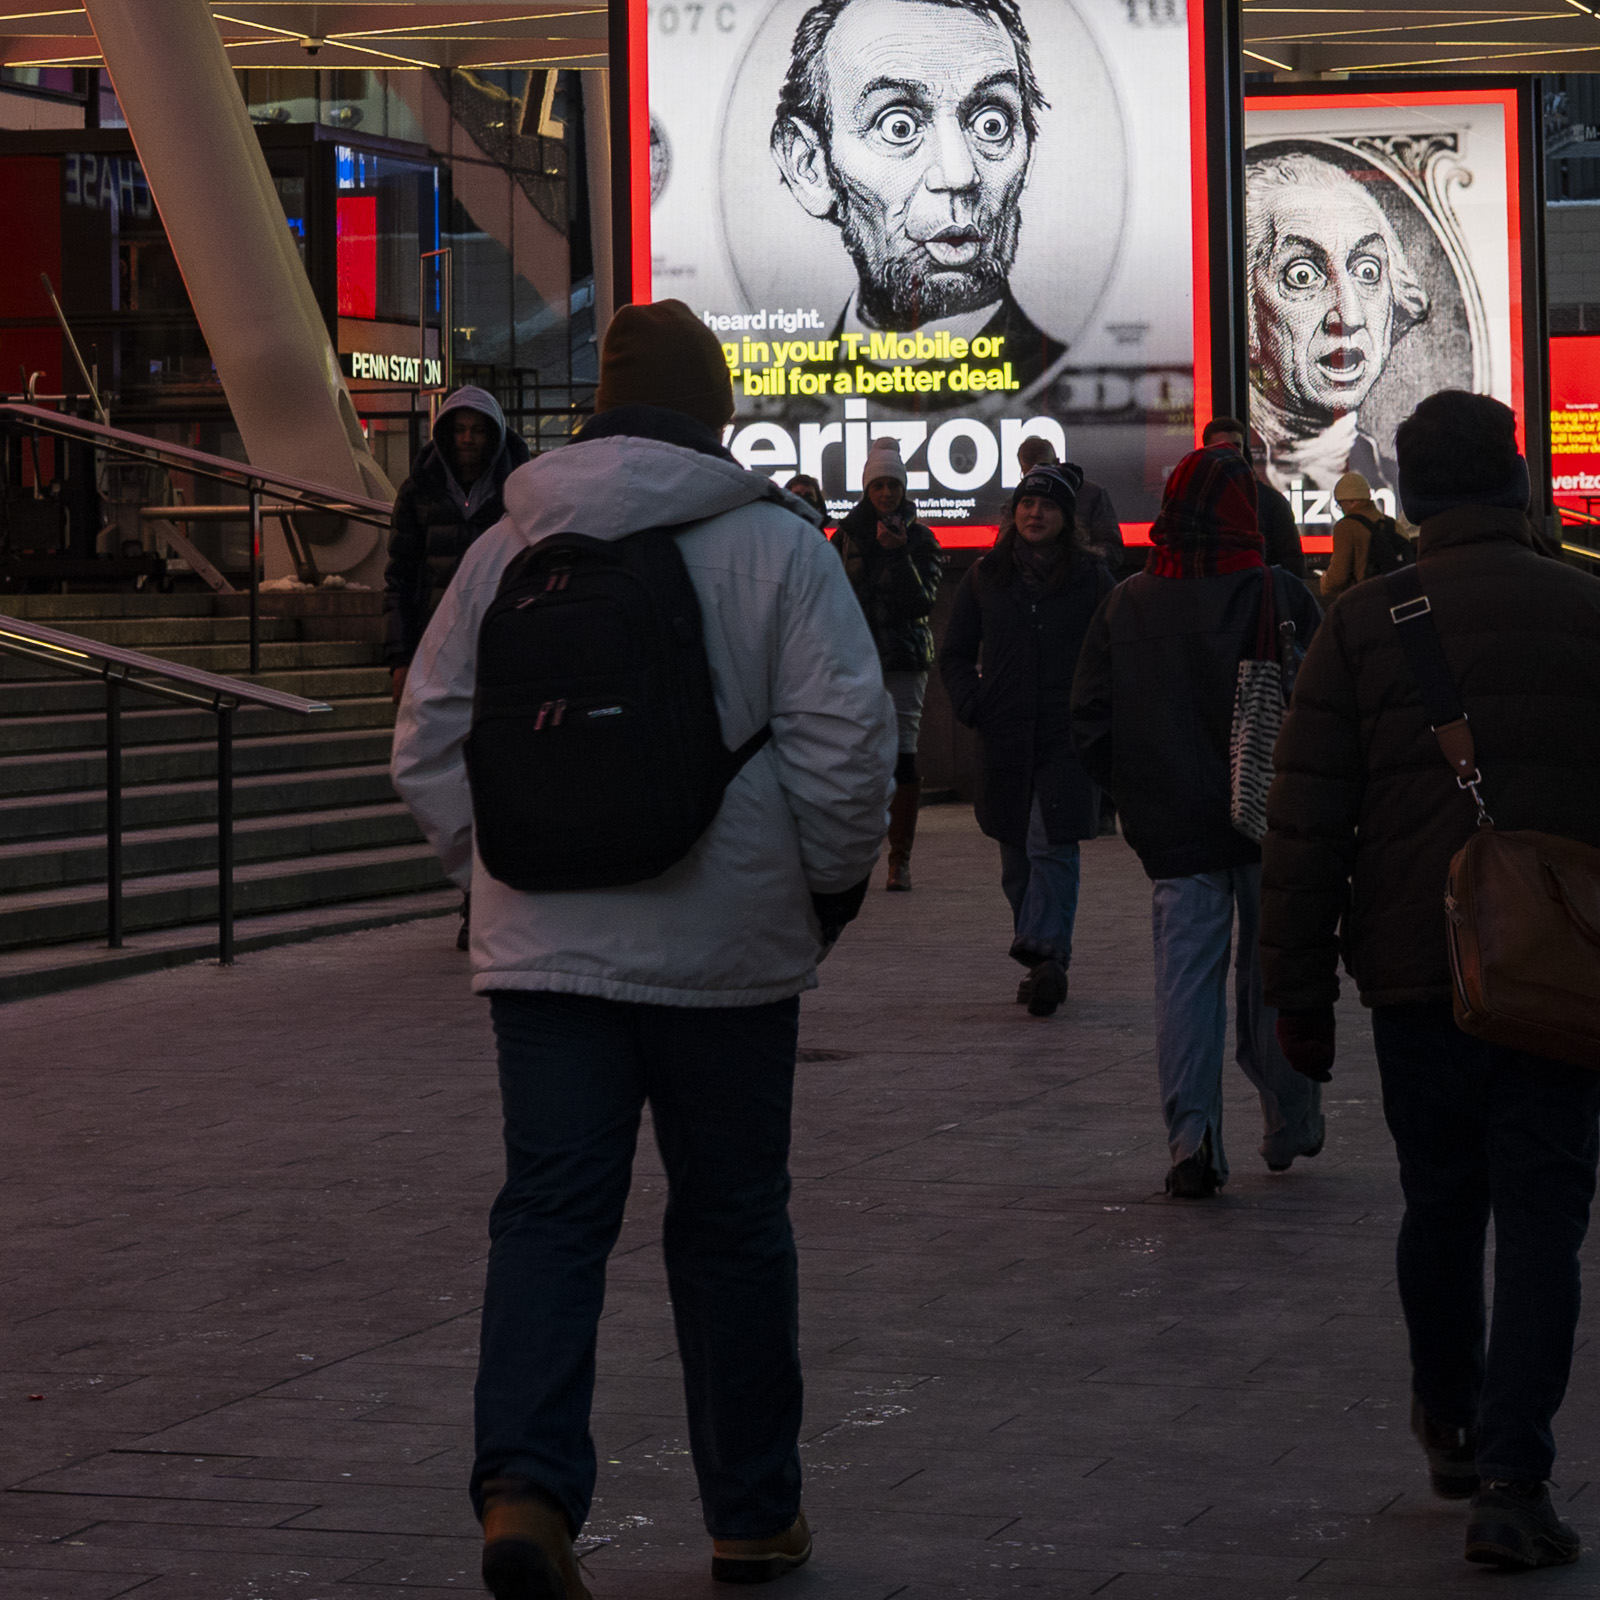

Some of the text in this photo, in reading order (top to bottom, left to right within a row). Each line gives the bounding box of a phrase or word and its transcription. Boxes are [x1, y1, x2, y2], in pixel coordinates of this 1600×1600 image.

[703, 308, 825, 333] heard right.
[742, 336, 770, 363] in
[771, 340, 840, 368] your
[841, 330, 969, 362] T-Mobile
[971, 333, 1004, 359] or
[352, 352, 442, 385] PENN STATON
[743, 368, 786, 396] bill
[788, 367, 831, 395] for
[833, 371, 852, 395] a
[856, 365, 947, 394] better
[948, 361, 1020, 391] deal.
